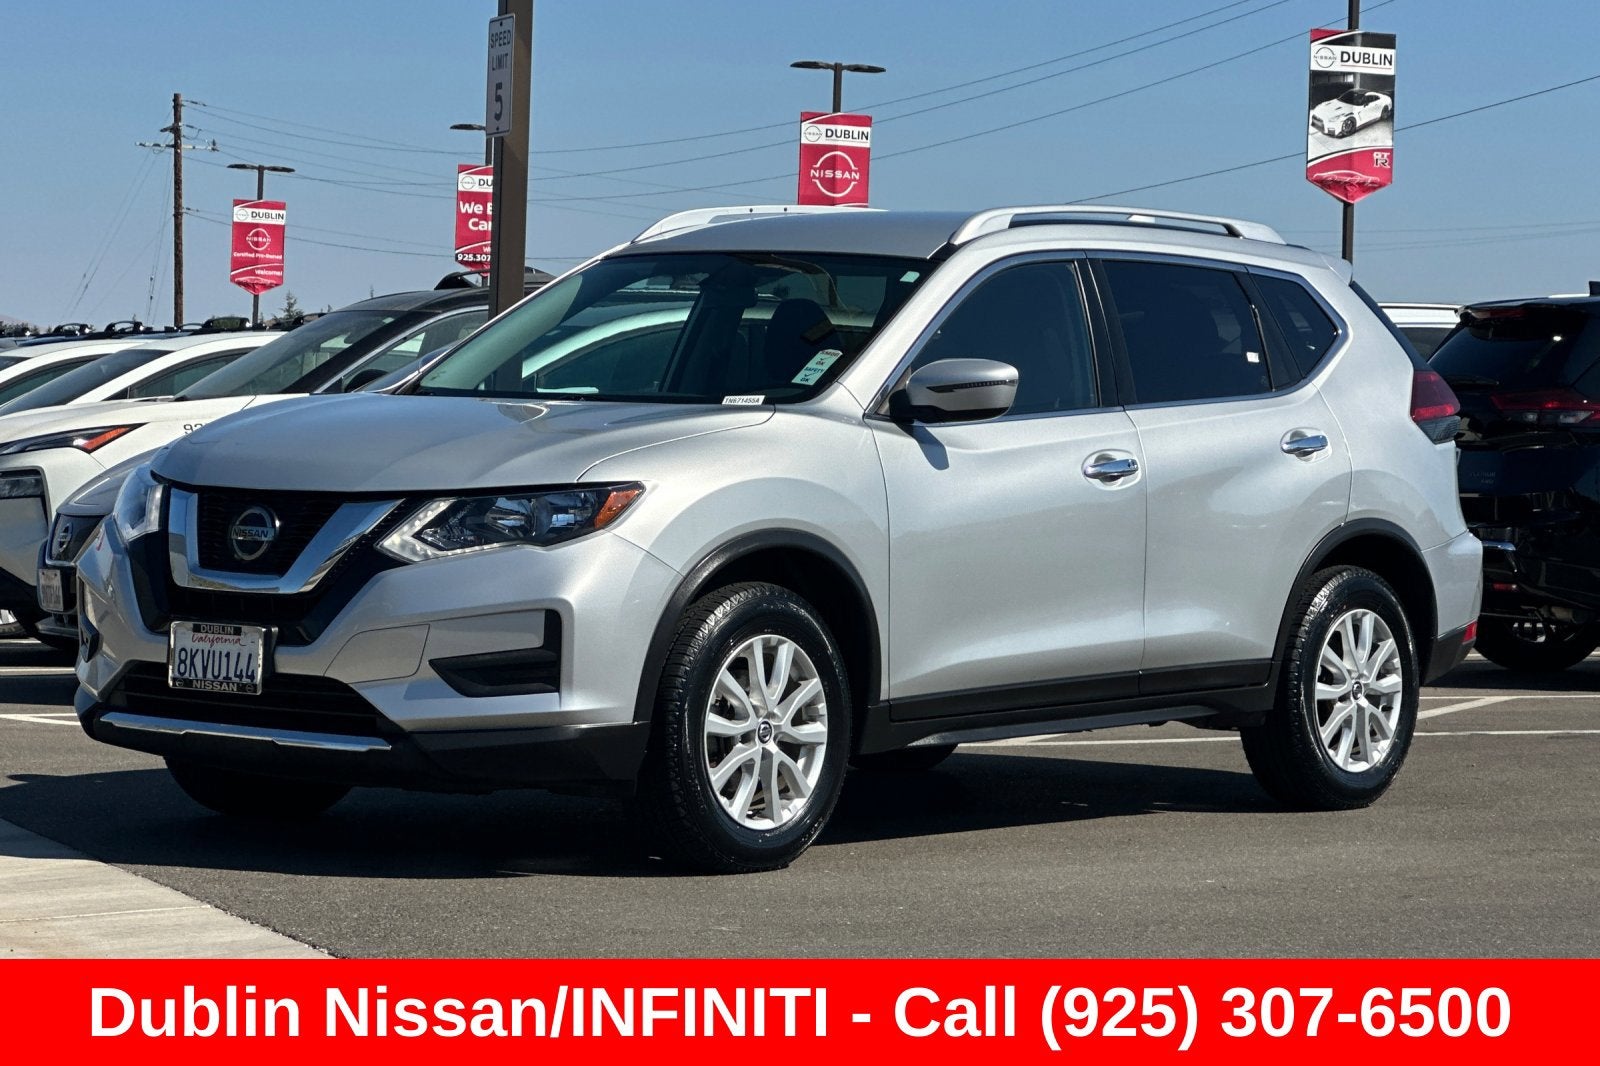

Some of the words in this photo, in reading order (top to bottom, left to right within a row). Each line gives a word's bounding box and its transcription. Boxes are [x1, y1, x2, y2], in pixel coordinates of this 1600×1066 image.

[490, 30, 511, 48] SPEED
[492, 53, 509, 71] LIMIT
[1341, 51, 1393, 66] DUBLIN
[494, 82, 503, 122] 5
[825, 128, 869, 141] DUBLIN
[810, 169, 860, 180] NISSAN
[459, 201, 483, 214] We
[251, 211, 284, 220] DUBLIN
[233, 528, 269, 538] NISSAN
[200, 625, 234, 634] DUBLIN
[192, 634, 246, 648] California
[177, 647, 256, 682] 8KVU144
[192, 680, 238, 692] NISSAN
